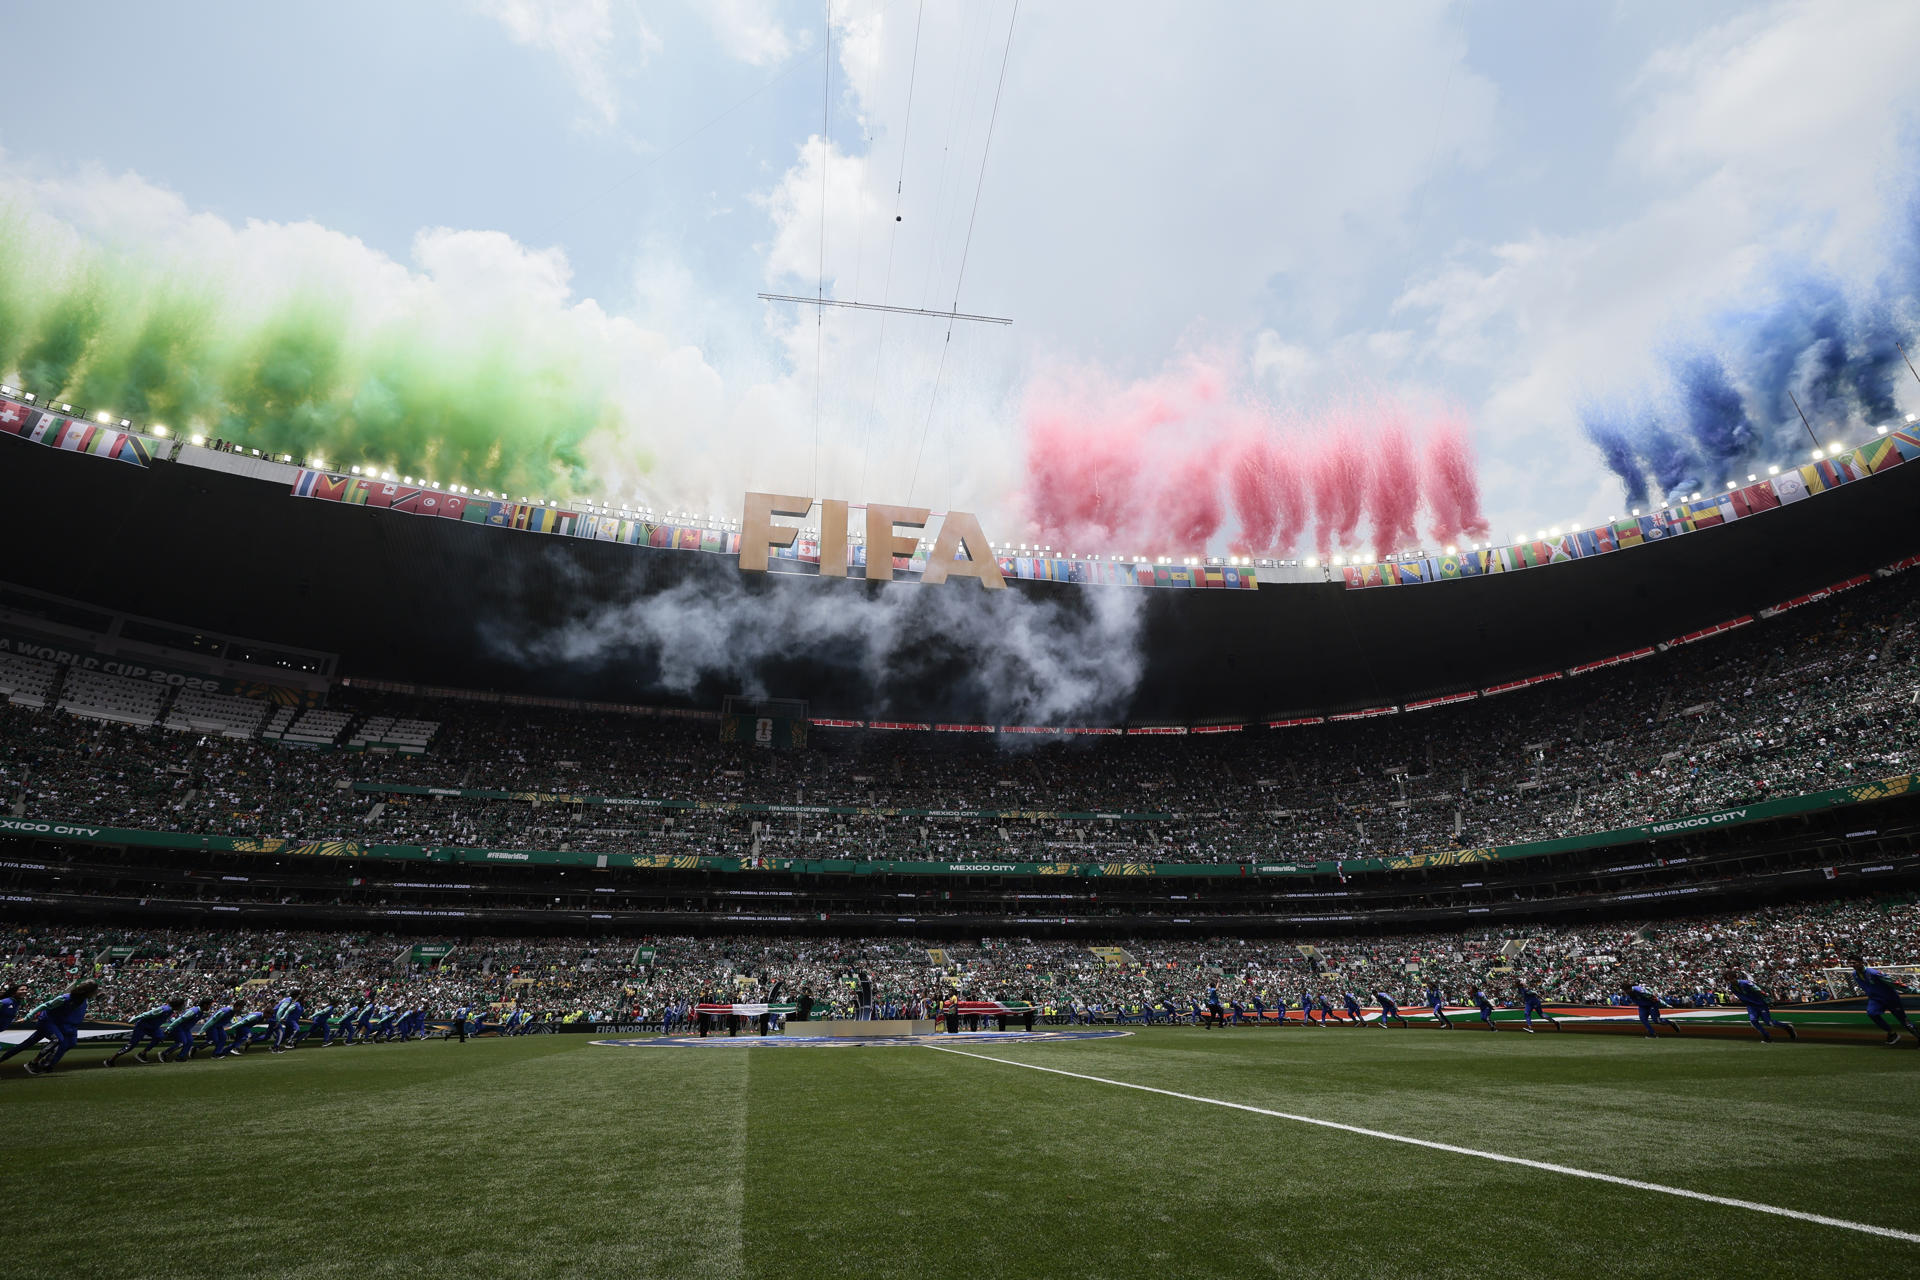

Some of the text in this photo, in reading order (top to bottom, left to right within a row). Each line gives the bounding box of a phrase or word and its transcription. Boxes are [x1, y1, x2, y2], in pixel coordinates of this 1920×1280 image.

[739, 492, 1007, 589] FIFA
[17, 641, 100, 669] WORLD
[103, 662, 147, 677] CUP
[148, 671, 221, 691] 2026
[53, 825, 100, 837] CITY
[1652, 809, 1748, 833] MEXICO CITY
[596, 1025, 616, 1033] FIFA
[618, 1025, 652, 1033] WORLD
